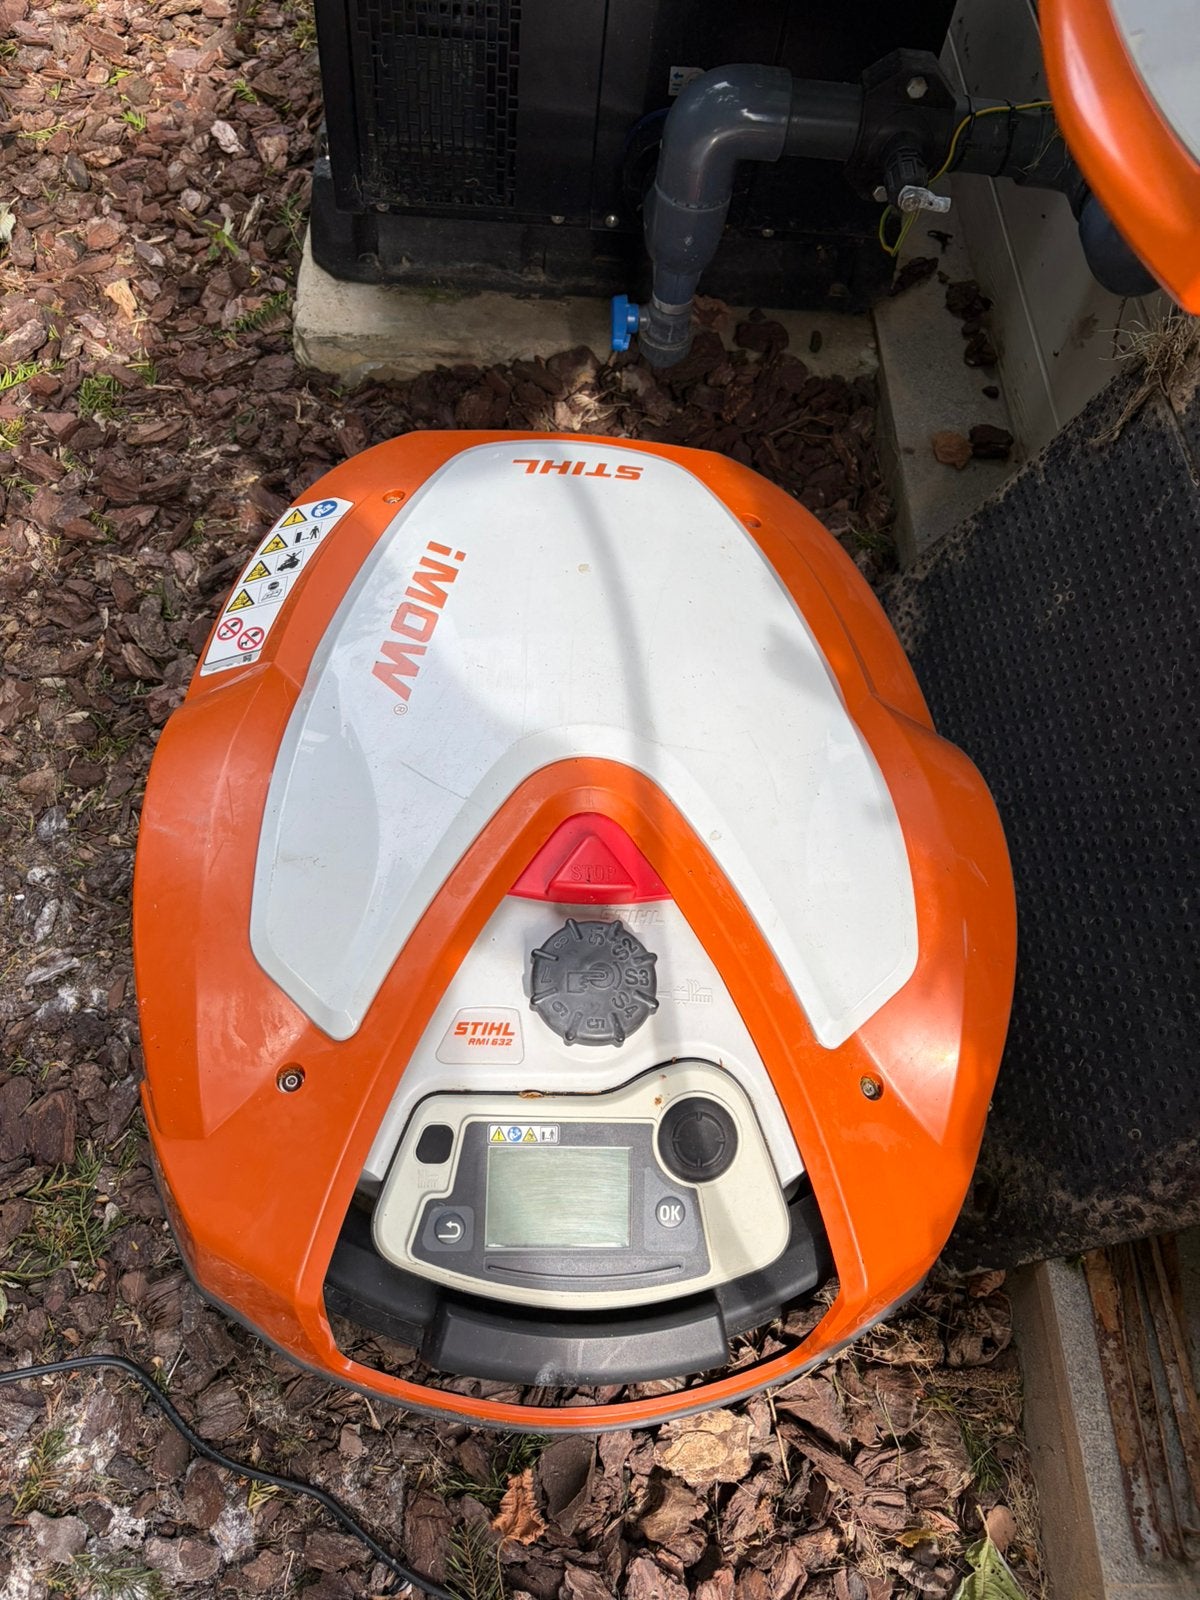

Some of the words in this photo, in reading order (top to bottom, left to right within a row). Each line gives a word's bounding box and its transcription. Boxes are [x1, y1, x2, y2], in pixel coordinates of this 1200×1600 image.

[512, 459, 644, 481] STIHL
[571, 864, 617, 881] STOP
[611, 938, 639, 961] S2
[624, 967, 650, 987] S3
[611, 991, 639, 1019] S4
[453, 1021, 515, 1036] STIHL
[586, 1017, 606, 1030] 5
[467, 1037, 490, 1046] RMI
[490, 1038, 513, 1047] 632
[659, 1204, 681, 1221] OK
